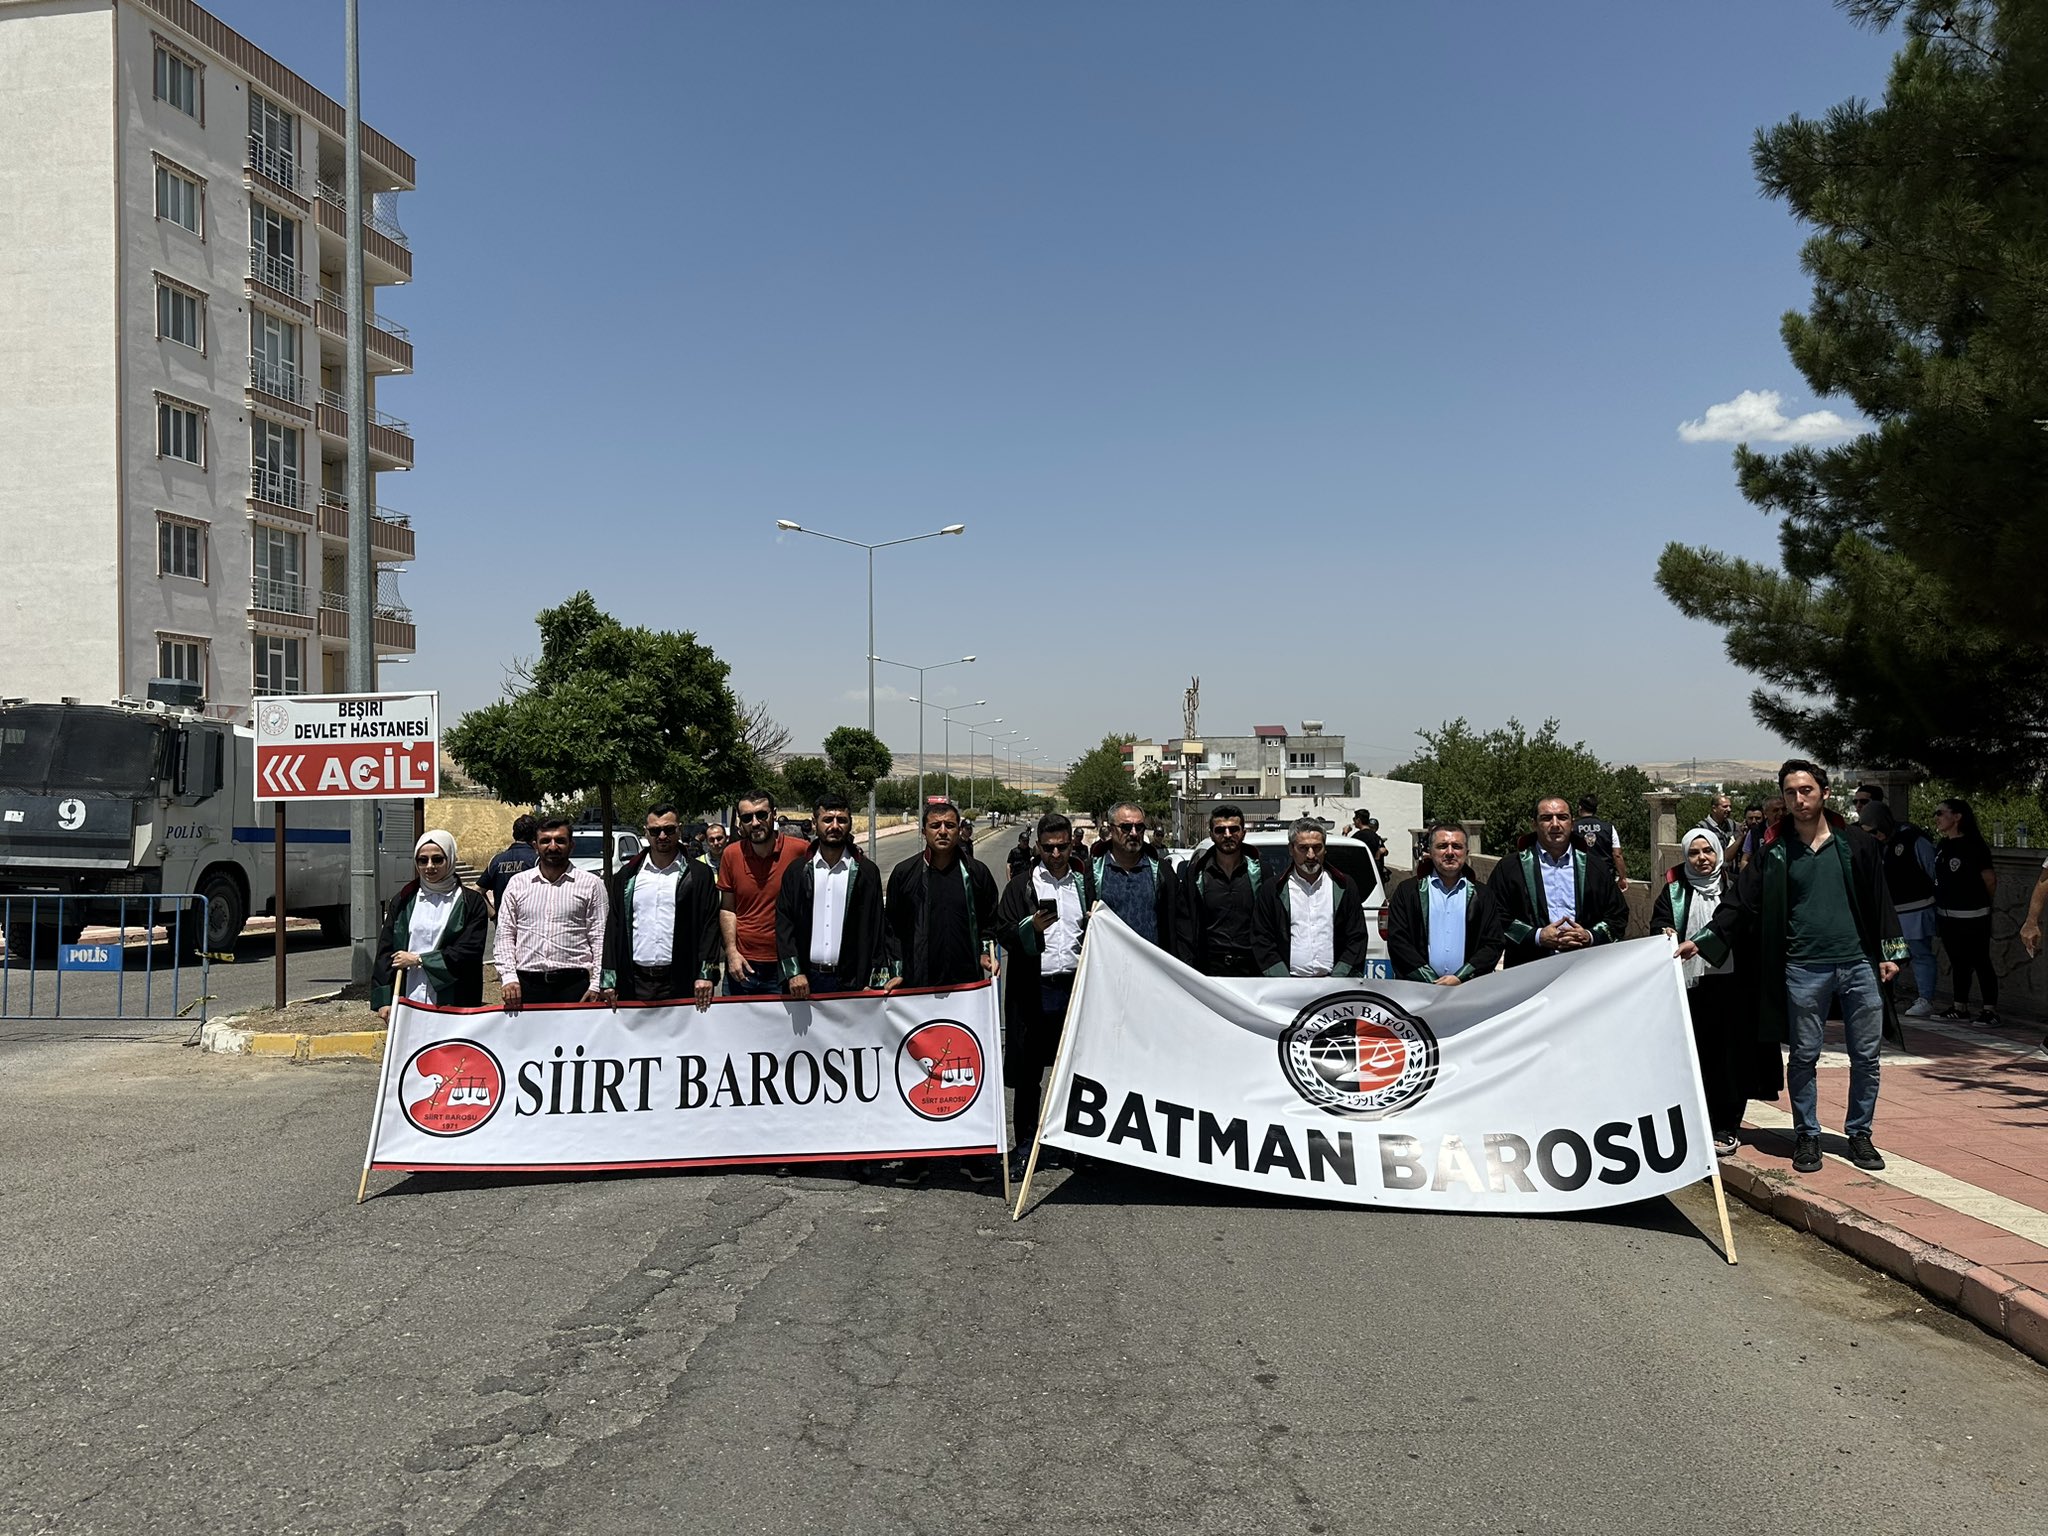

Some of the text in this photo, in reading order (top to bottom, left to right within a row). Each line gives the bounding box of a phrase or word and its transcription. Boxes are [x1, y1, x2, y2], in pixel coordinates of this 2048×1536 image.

[294, 717, 428, 739] DEVLET HASTANESİ
[316, 747, 426, 791] ACİL
[57, 798, 87, 831] 9
[165, 822, 204, 839] POLİS
[497, 860, 524, 874] TEM
[69, 946, 108, 963] POLİS
[1295, 1005, 1355, 1046] BATMAN
[514, 1044, 883, 1117] SİİRT BAROSU
[445, 1113, 478, 1121] BAROSU
[1063, 1072, 1688, 1194] BATMAN BAROSU
